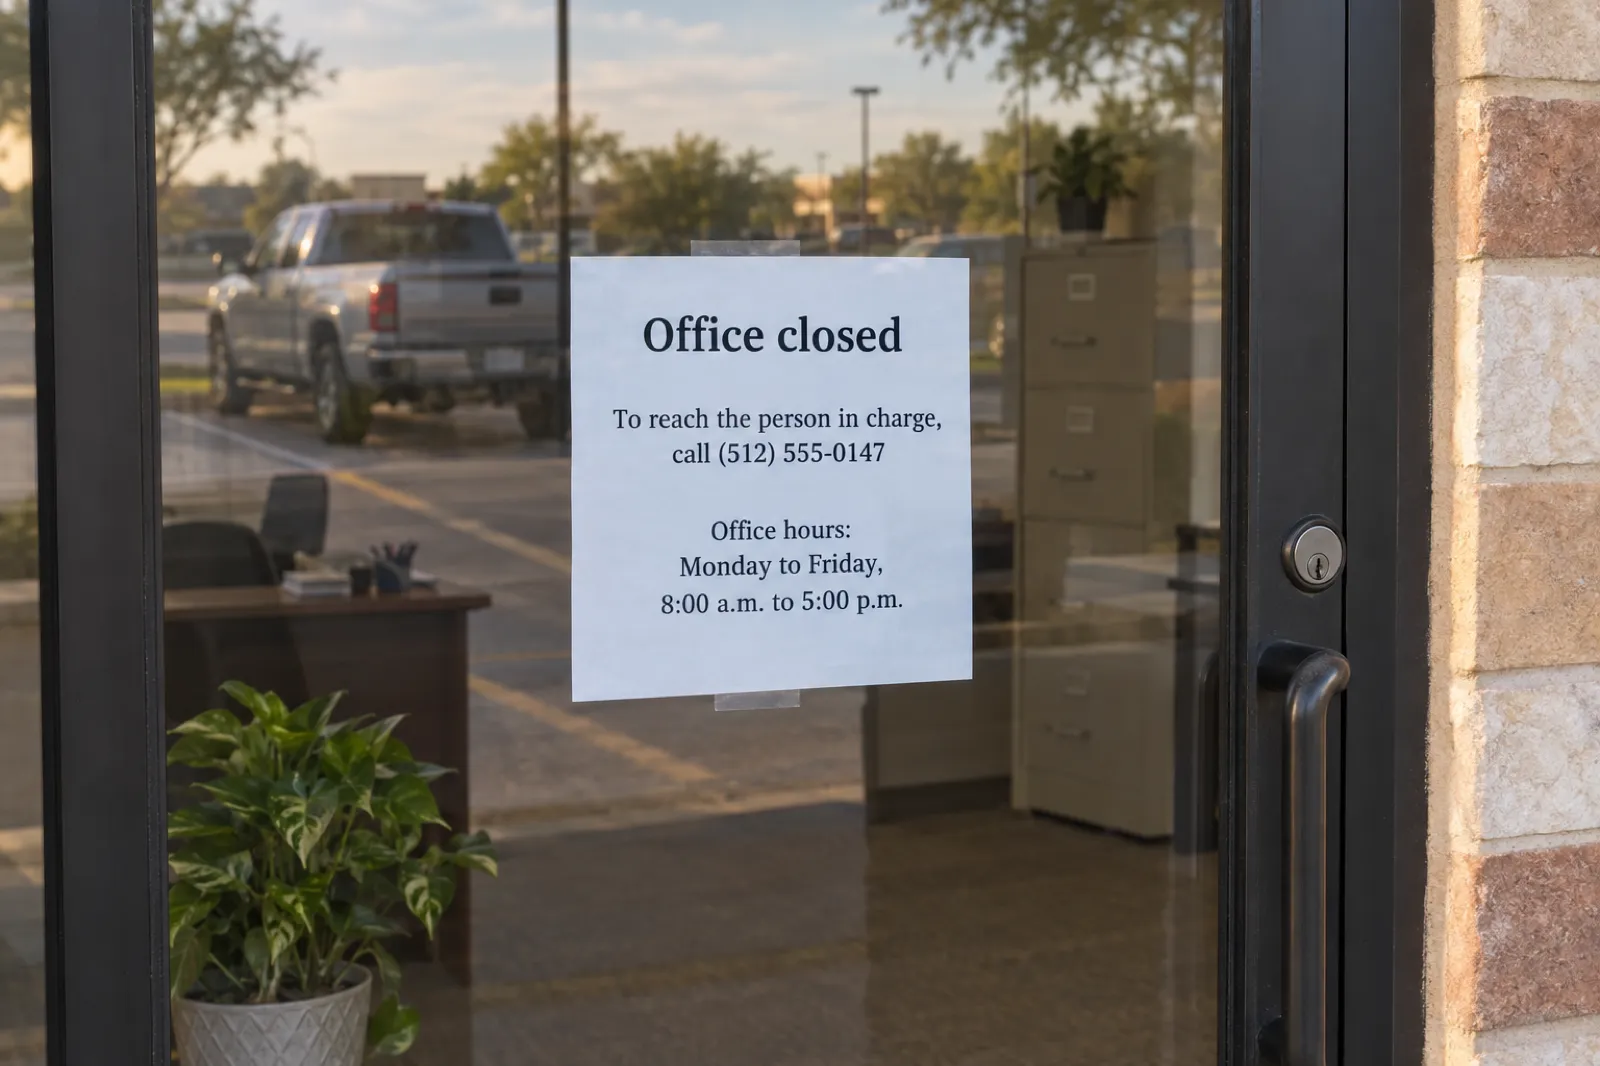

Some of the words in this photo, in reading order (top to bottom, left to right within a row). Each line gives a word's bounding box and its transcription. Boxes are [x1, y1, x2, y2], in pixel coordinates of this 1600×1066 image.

[644, 315, 764, 352] Office
[778, 315, 902, 352] closed
[613, 409, 641, 429] To
[649, 408, 709, 428] reach
[717, 408, 750, 428] the
[758, 413, 831, 433] person
[838, 408, 859, 427] in
[867, 407, 942, 433] charge,
[673, 442, 710, 463] call
[719, 442, 775, 467] (512)
[784, 442, 885, 463] 555-0147
[711, 519, 776, 540] Office
[784, 519, 851, 539] hours:
[680, 555, 772, 580] Monday
[779, 557, 800, 574] to
[809, 552, 883, 578] Friday,
[661, 593, 709, 614] 8:00
[718, 598, 764, 612] a.m.
[772, 594, 794, 611] to
[802, 590, 849, 610] 5:00
[857, 594, 903, 614] p.m.
